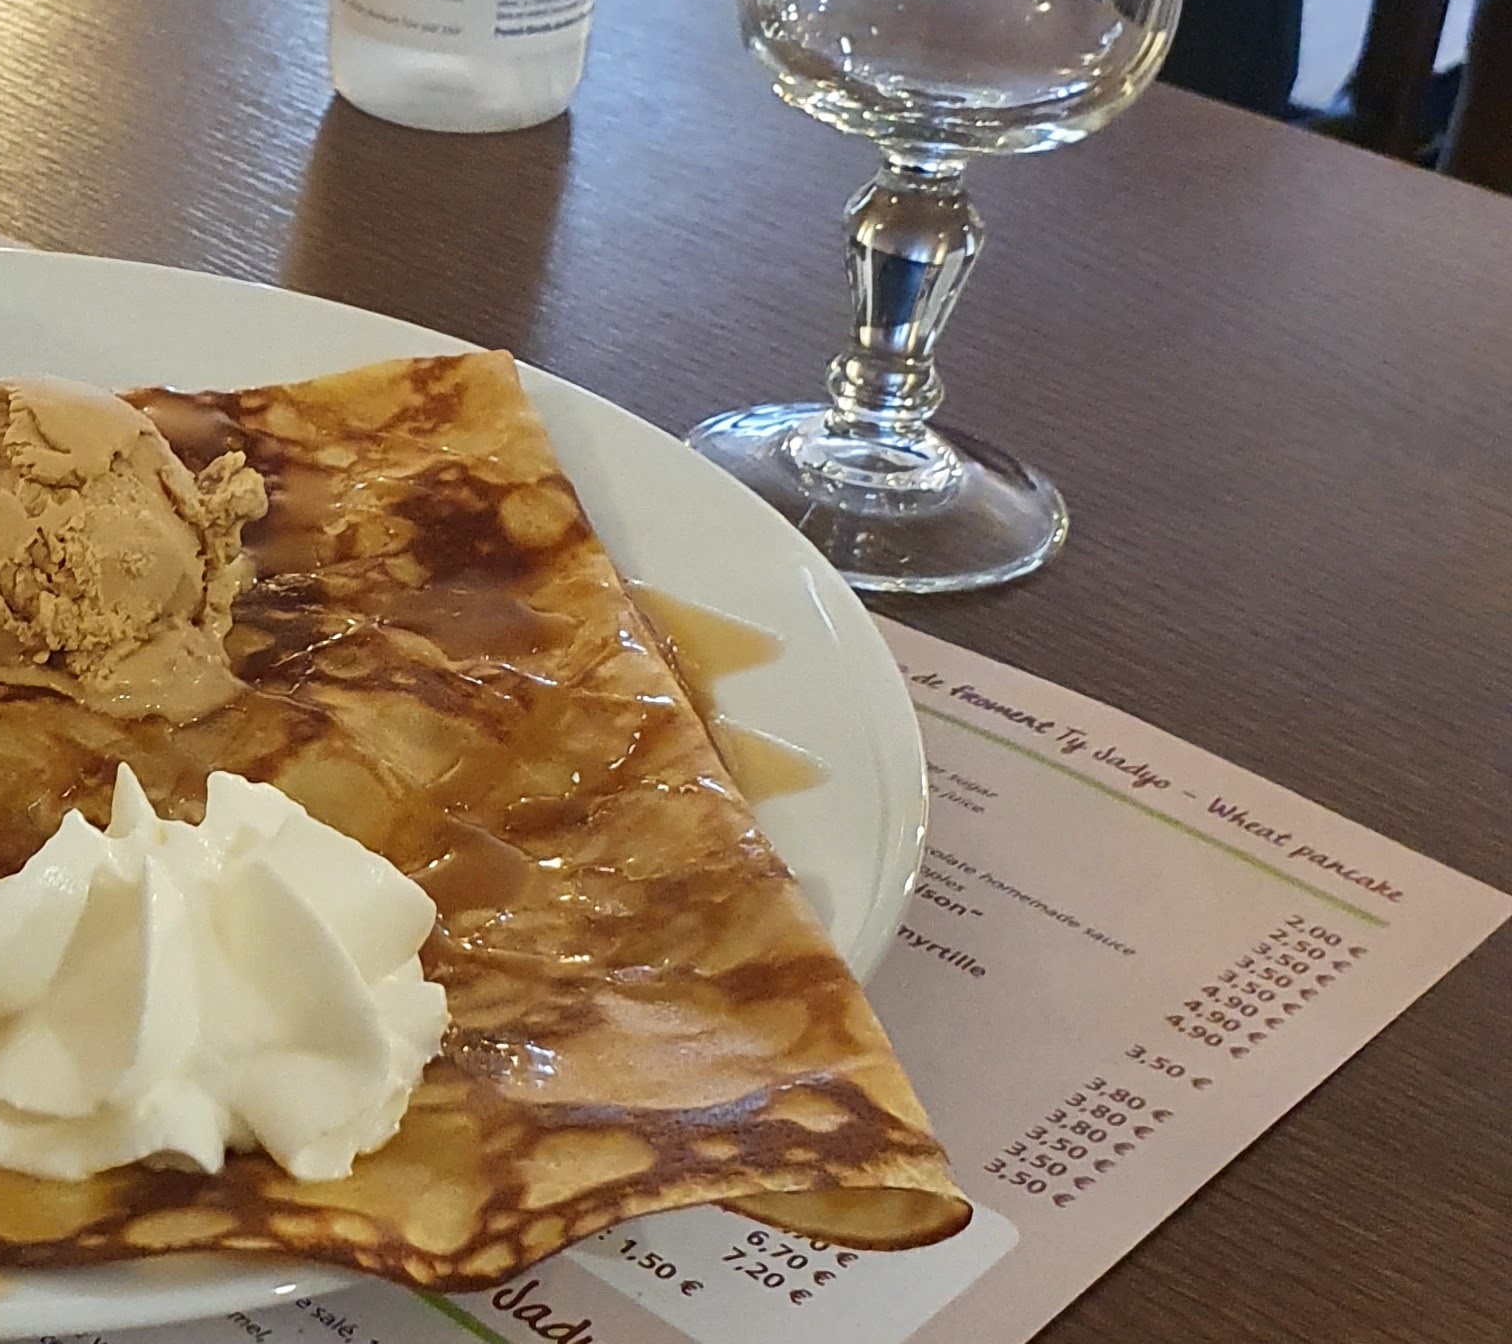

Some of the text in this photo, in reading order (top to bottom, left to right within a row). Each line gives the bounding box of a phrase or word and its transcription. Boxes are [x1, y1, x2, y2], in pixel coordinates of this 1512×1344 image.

[620, 1239, 677, 1280] 1,50
[722, 1246, 786, 1288] 7,20
[746, 1230, 809, 1270] 6,70
[310, 1307, 359, 1344] salé,
